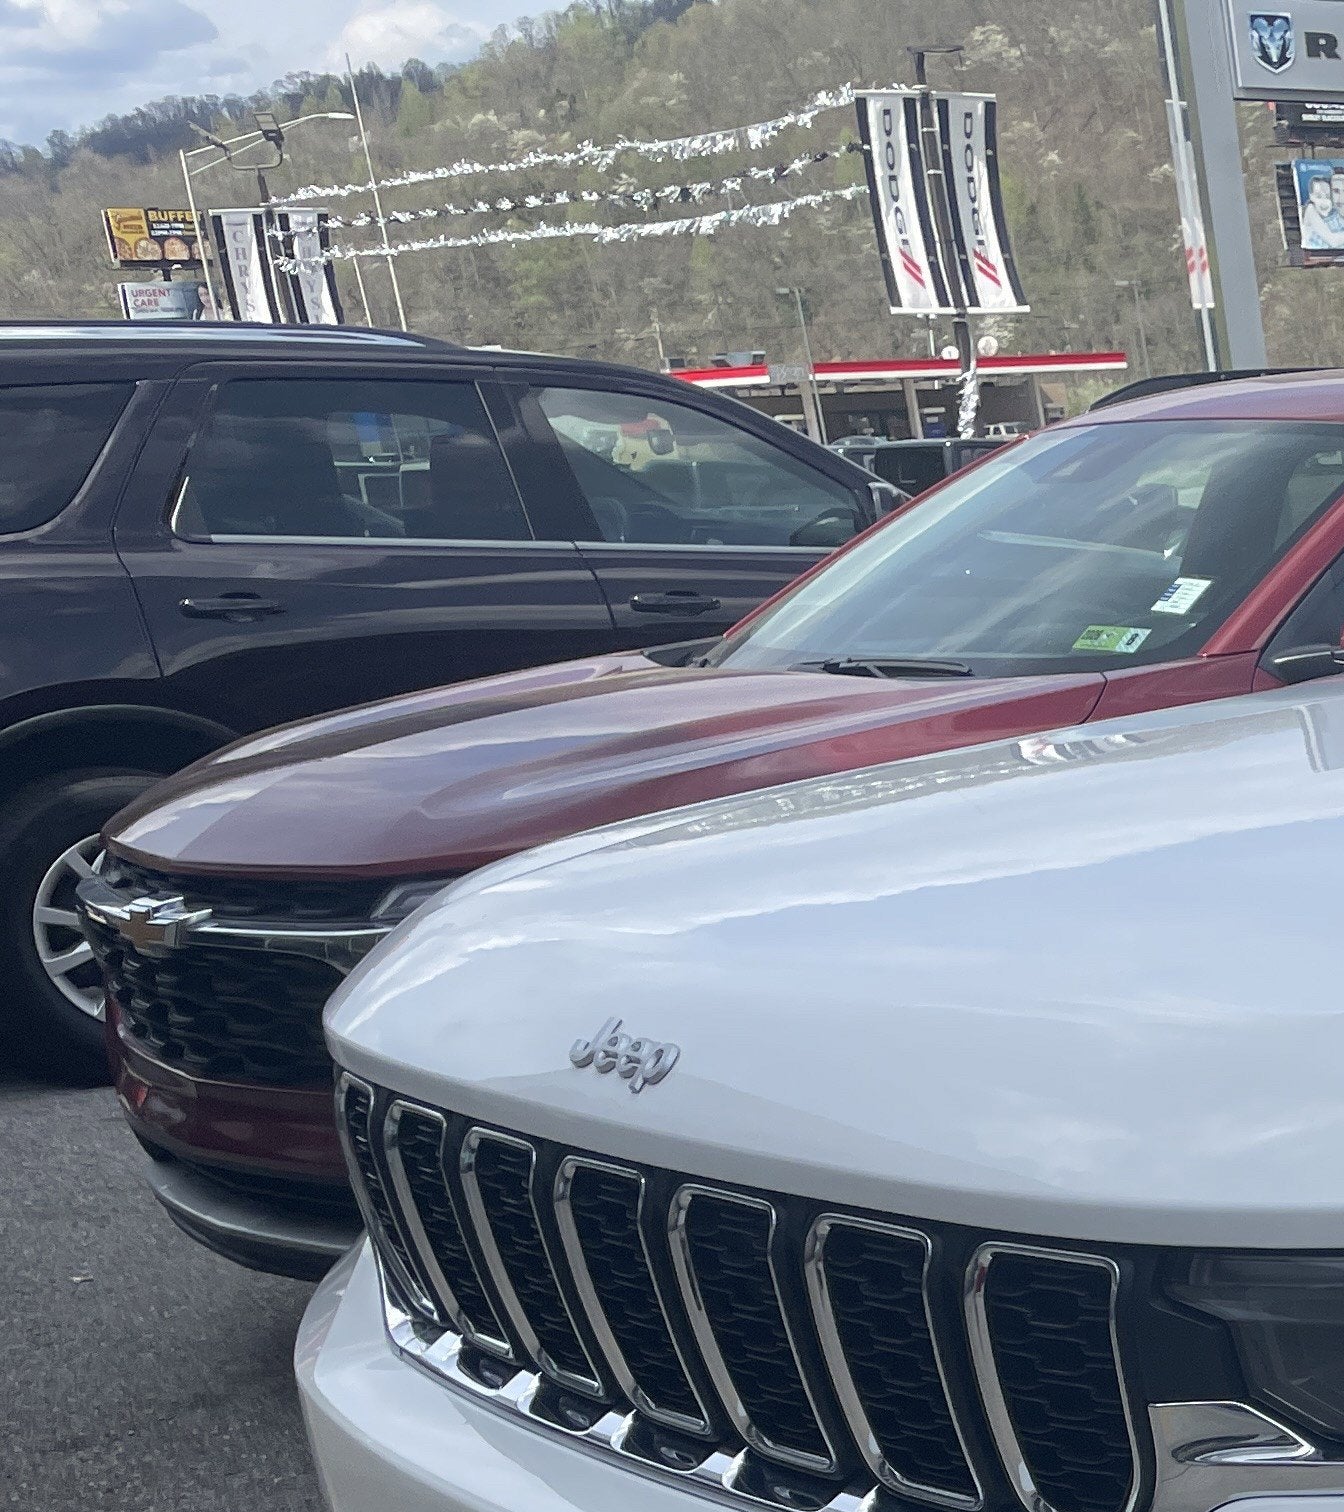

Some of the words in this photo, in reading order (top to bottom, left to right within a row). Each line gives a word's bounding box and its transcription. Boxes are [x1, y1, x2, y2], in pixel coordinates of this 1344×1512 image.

[131, 288, 171, 298] URGENT
[133, 299, 160, 307] CARE
[569, 1017, 681, 1094] Jeep
